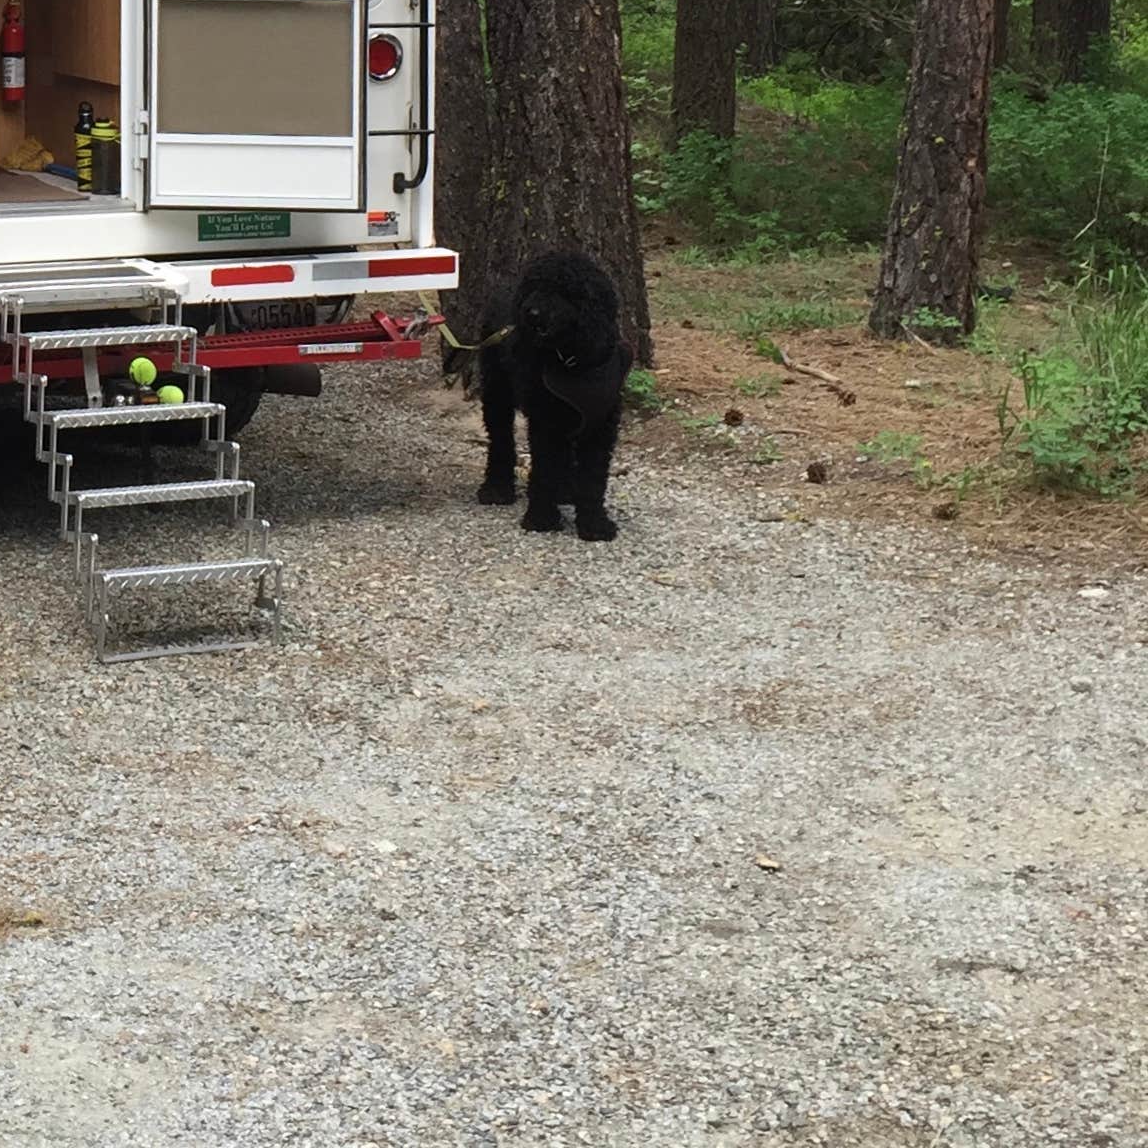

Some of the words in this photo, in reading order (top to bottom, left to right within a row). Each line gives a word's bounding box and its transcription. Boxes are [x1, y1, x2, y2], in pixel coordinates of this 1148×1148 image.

[216, 215, 233, 224] You
[234, 214, 253, 222] Love
[254, 213, 282, 222] Nature
[241, 223, 259, 231] Love
